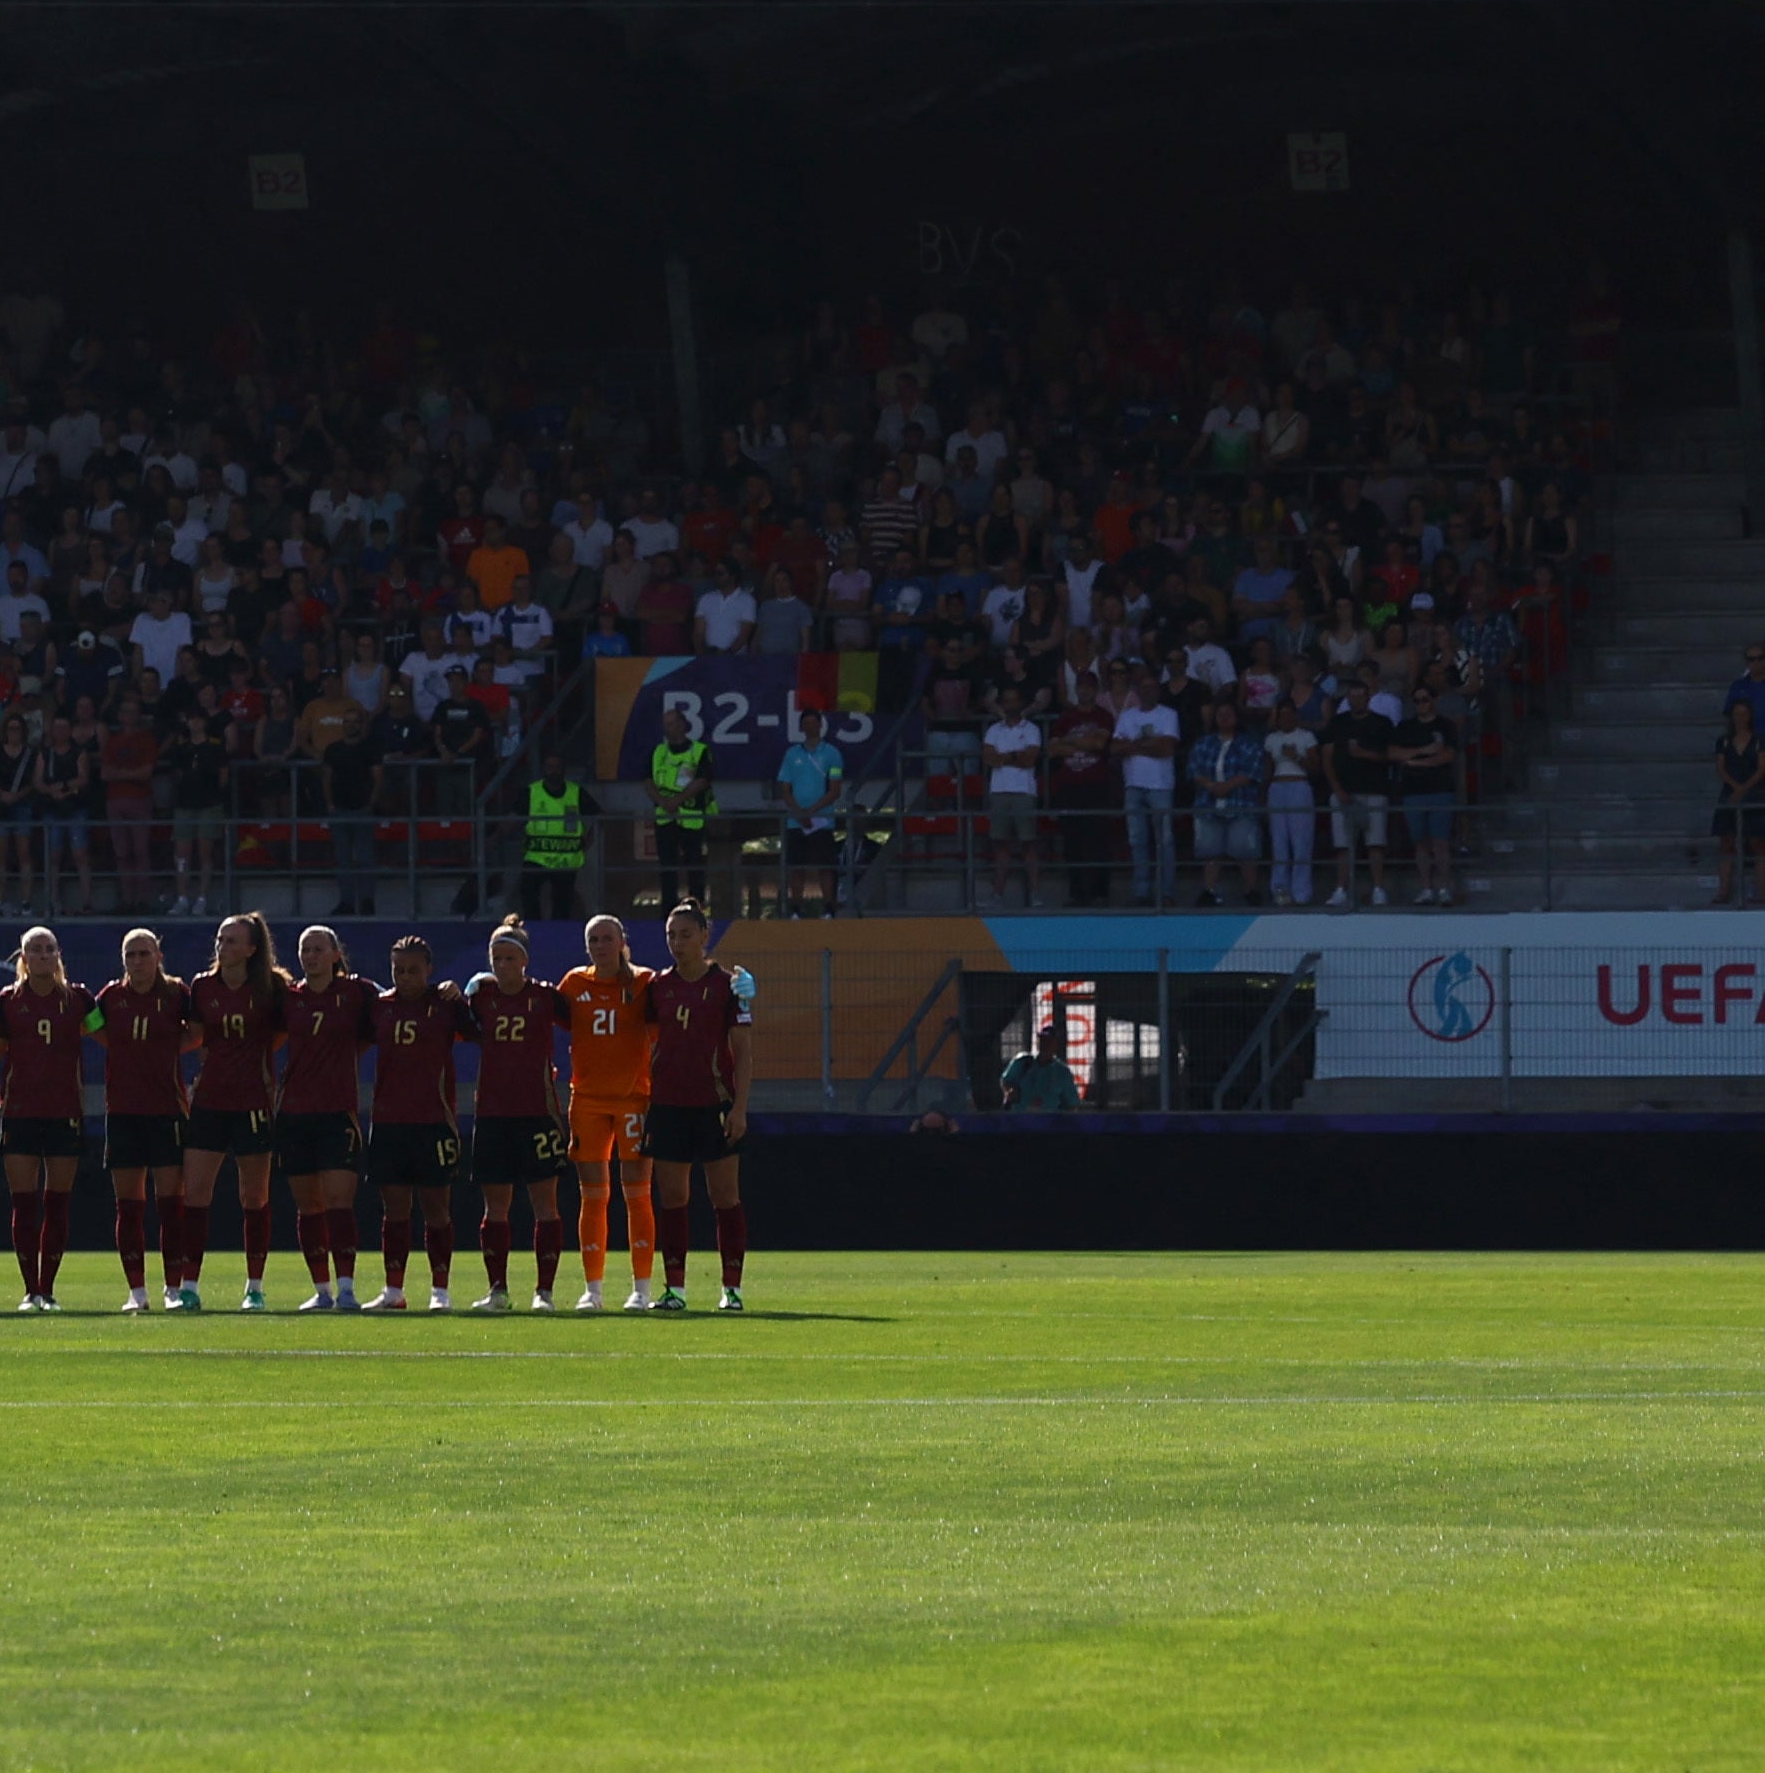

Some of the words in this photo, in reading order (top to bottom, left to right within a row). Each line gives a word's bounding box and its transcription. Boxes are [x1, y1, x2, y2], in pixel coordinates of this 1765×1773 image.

[257, 170, 301, 194] B2
[1596, 963, 1765, 1026] UEF
[131, 1014, 149, 1041] 11
[222, 1013, 245, 1039] 19
[311, 1011, 324, 1036] 7
[494, 1015, 526, 1042] 22
[592, 1009, 616, 1036] 21
[676, 1005, 690, 1029] 4
[37, 1019, 52, 1045] 9
[393, 1019, 416, 1045] 15
[435, 1137, 459, 1166] 15
[535, 1131, 566, 1160] 22
